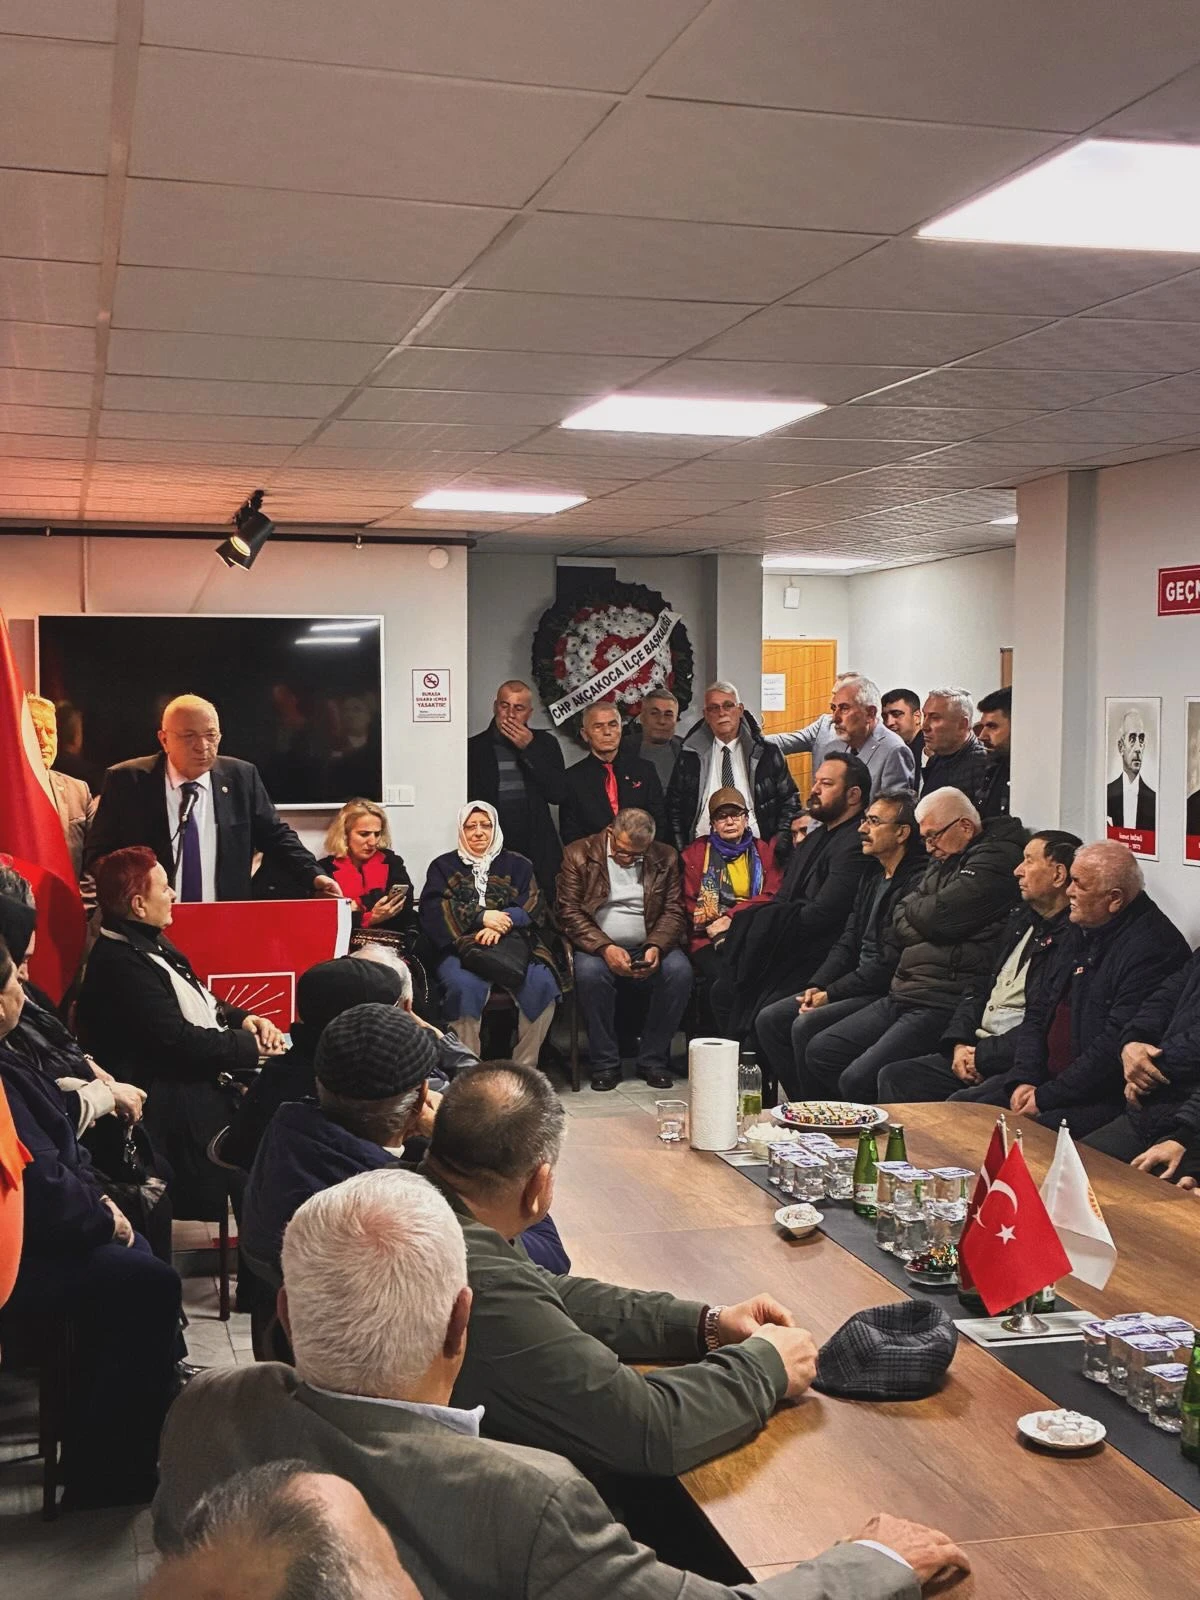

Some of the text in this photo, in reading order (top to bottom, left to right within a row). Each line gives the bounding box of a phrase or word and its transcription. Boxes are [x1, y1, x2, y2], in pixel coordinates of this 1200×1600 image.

[551, 702, 571, 719] CHP
[572, 667, 625, 706] AKÇAKOCA
[622, 649, 645, 672] İLÇE
